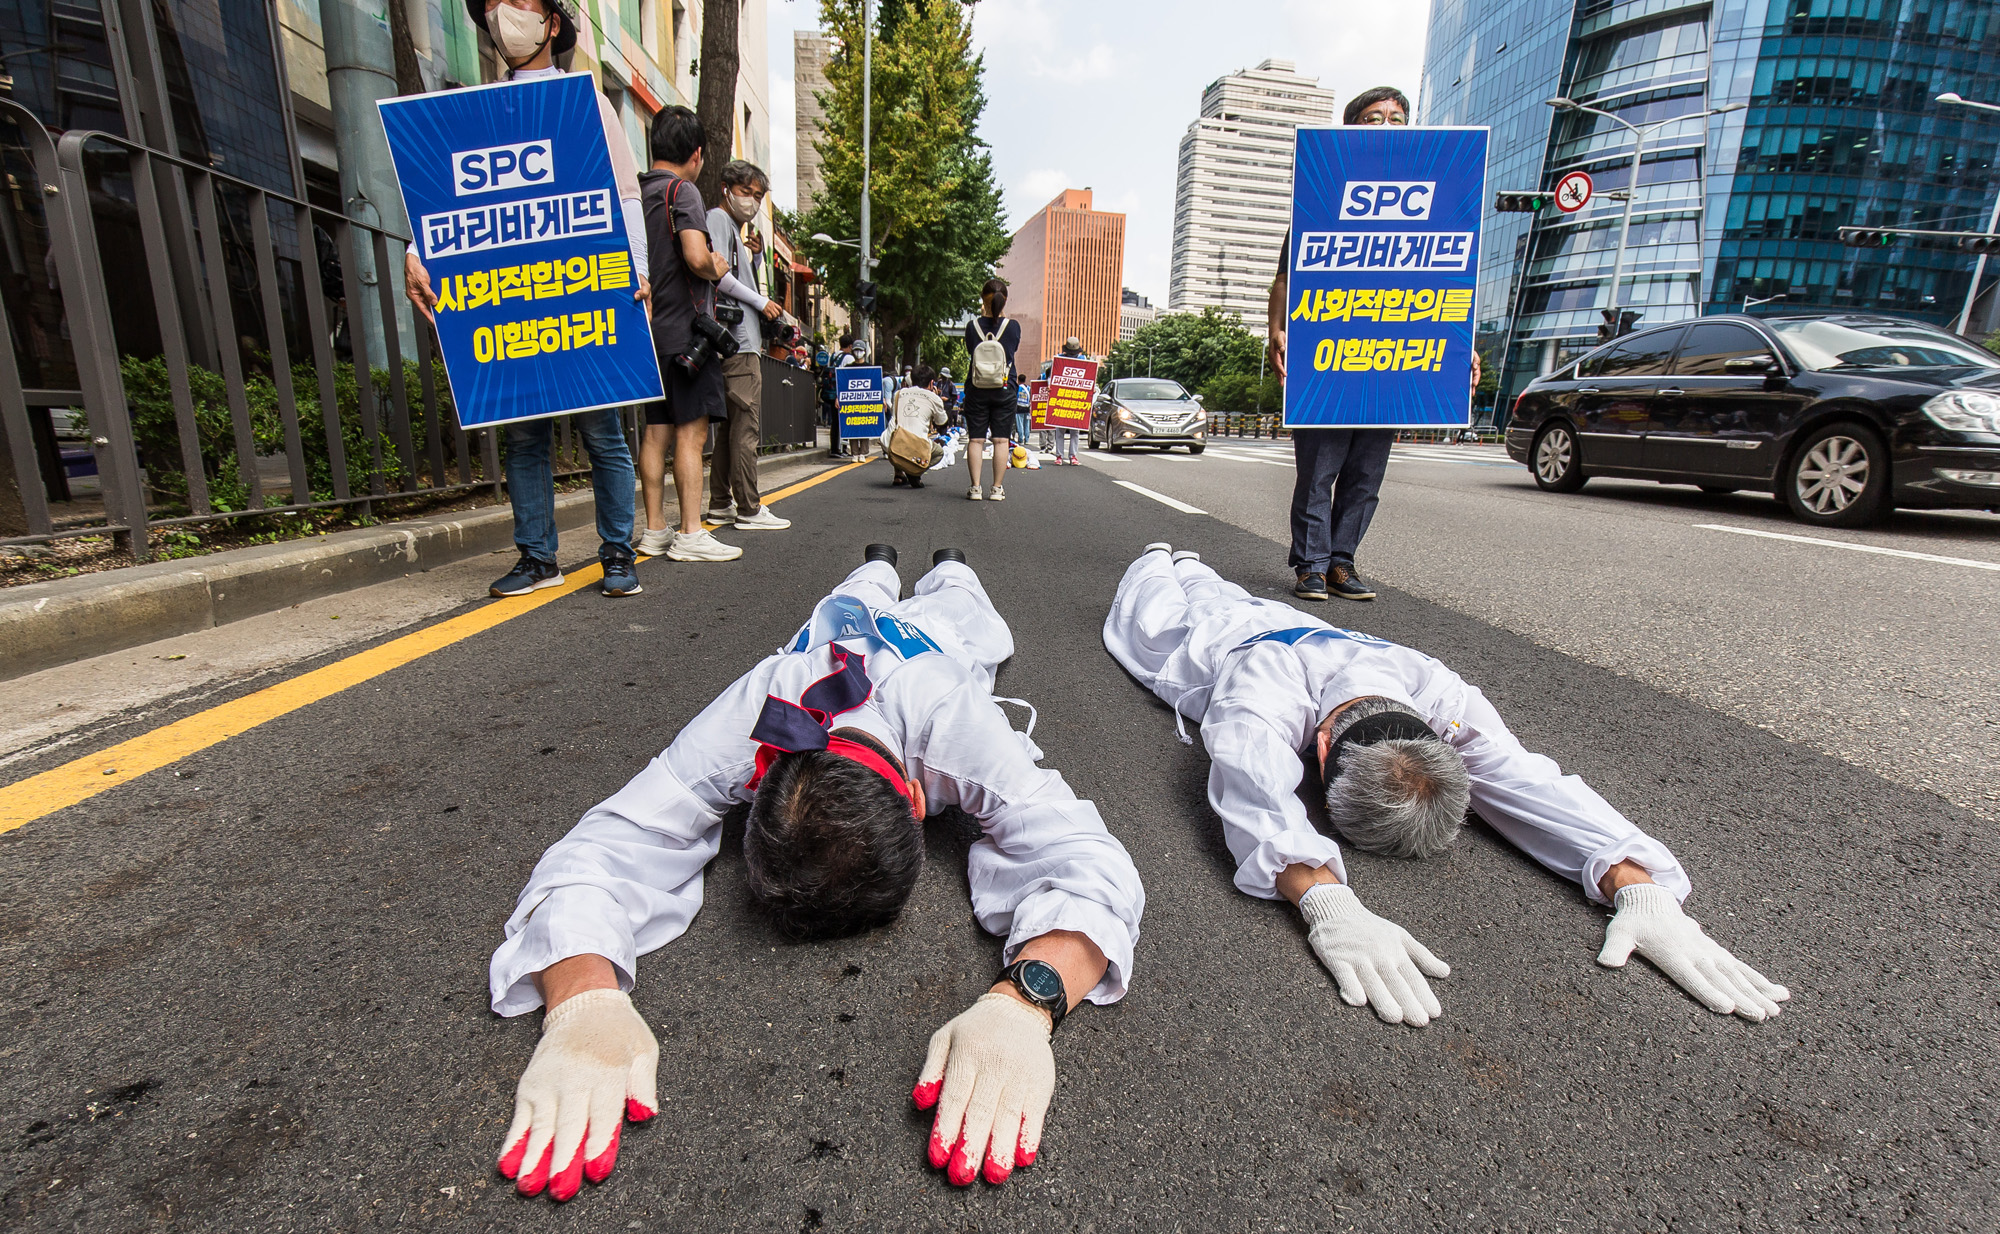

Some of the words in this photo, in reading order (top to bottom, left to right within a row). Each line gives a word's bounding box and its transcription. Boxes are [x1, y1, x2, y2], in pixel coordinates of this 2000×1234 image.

[460, 145, 548, 190] SPC
[1345, 184, 1429, 217] SPC
[428, 193, 607, 255] 파리바게뜨
[1302, 235, 1467, 268] 파리바게뜨
[434, 251, 631, 313] 사회적합의를
[1290, 289, 1473, 322] 사회적합의를
[473, 308, 617, 364] 이행하라!
[1313, 338, 1447, 372] 이행하라!
[850, 380, 870, 388] SPC
[1053, 377, 1092, 388] 파리바게뜨
[1064, 368, 1084, 377] SPC
[840, 404, 883, 413] 사회적합의를
[841, 391, 880, 400] 파리바게뜨
[846, 416, 879, 425] 이행하라!
